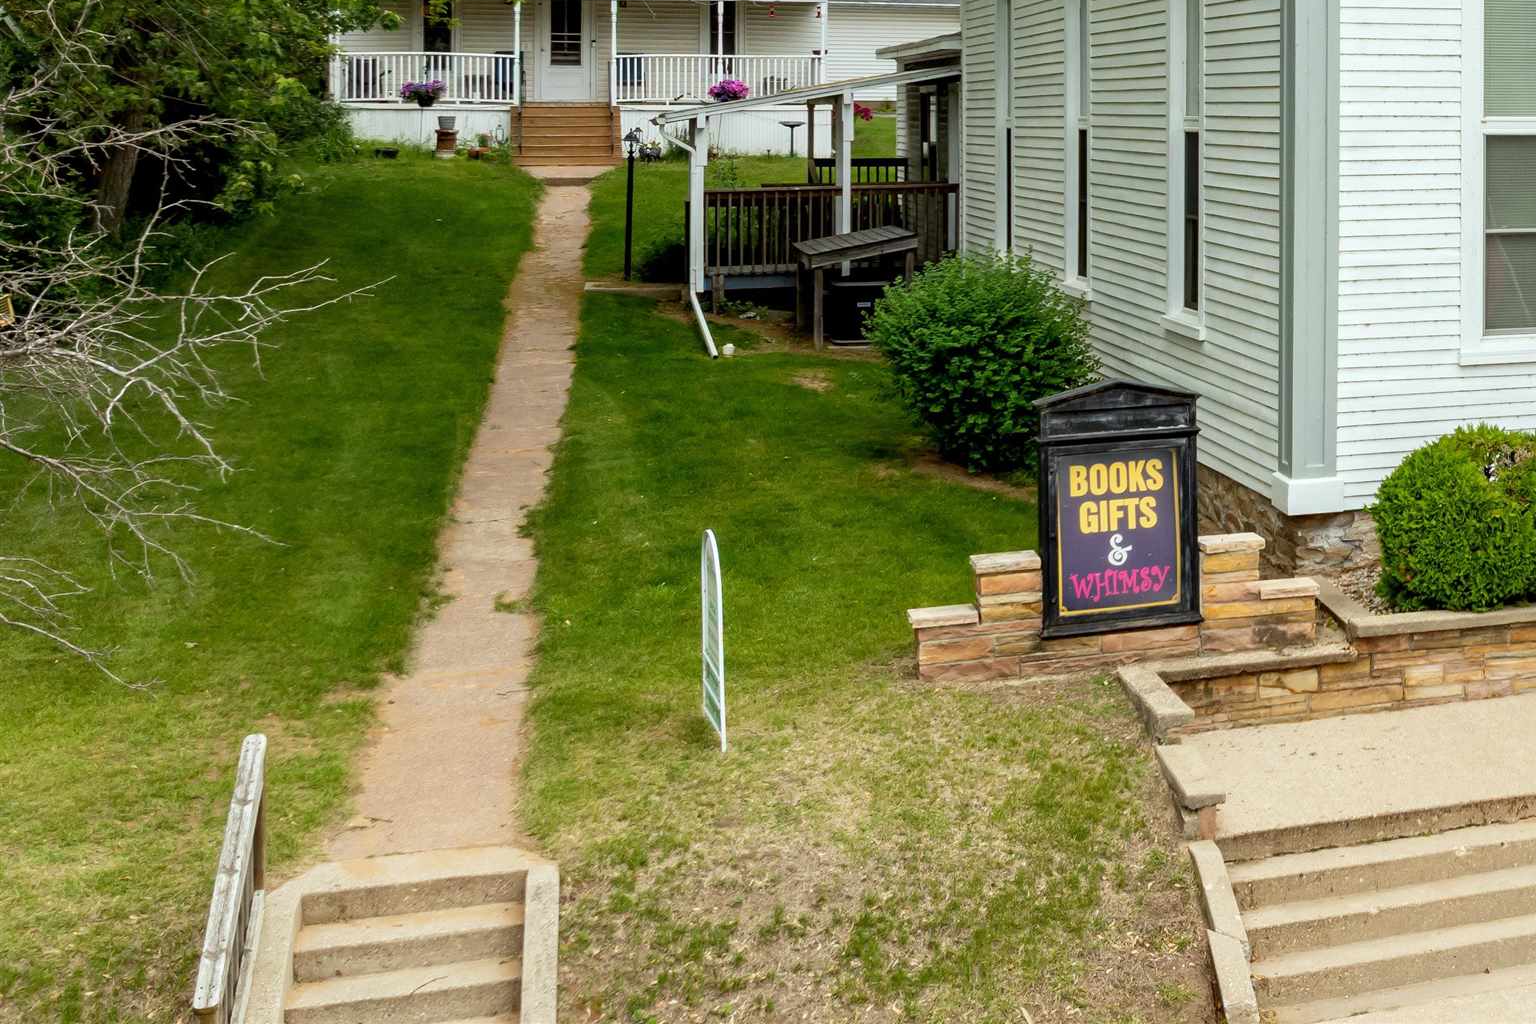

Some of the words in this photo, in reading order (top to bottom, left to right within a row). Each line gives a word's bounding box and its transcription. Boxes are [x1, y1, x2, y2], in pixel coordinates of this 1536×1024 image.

[1069, 458, 1164, 497] BOOKS
[1078, 495, 1158, 534] GIFTS
[1107, 533, 1133, 566] &
[1070, 565, 1171, 603] WHIMSY
